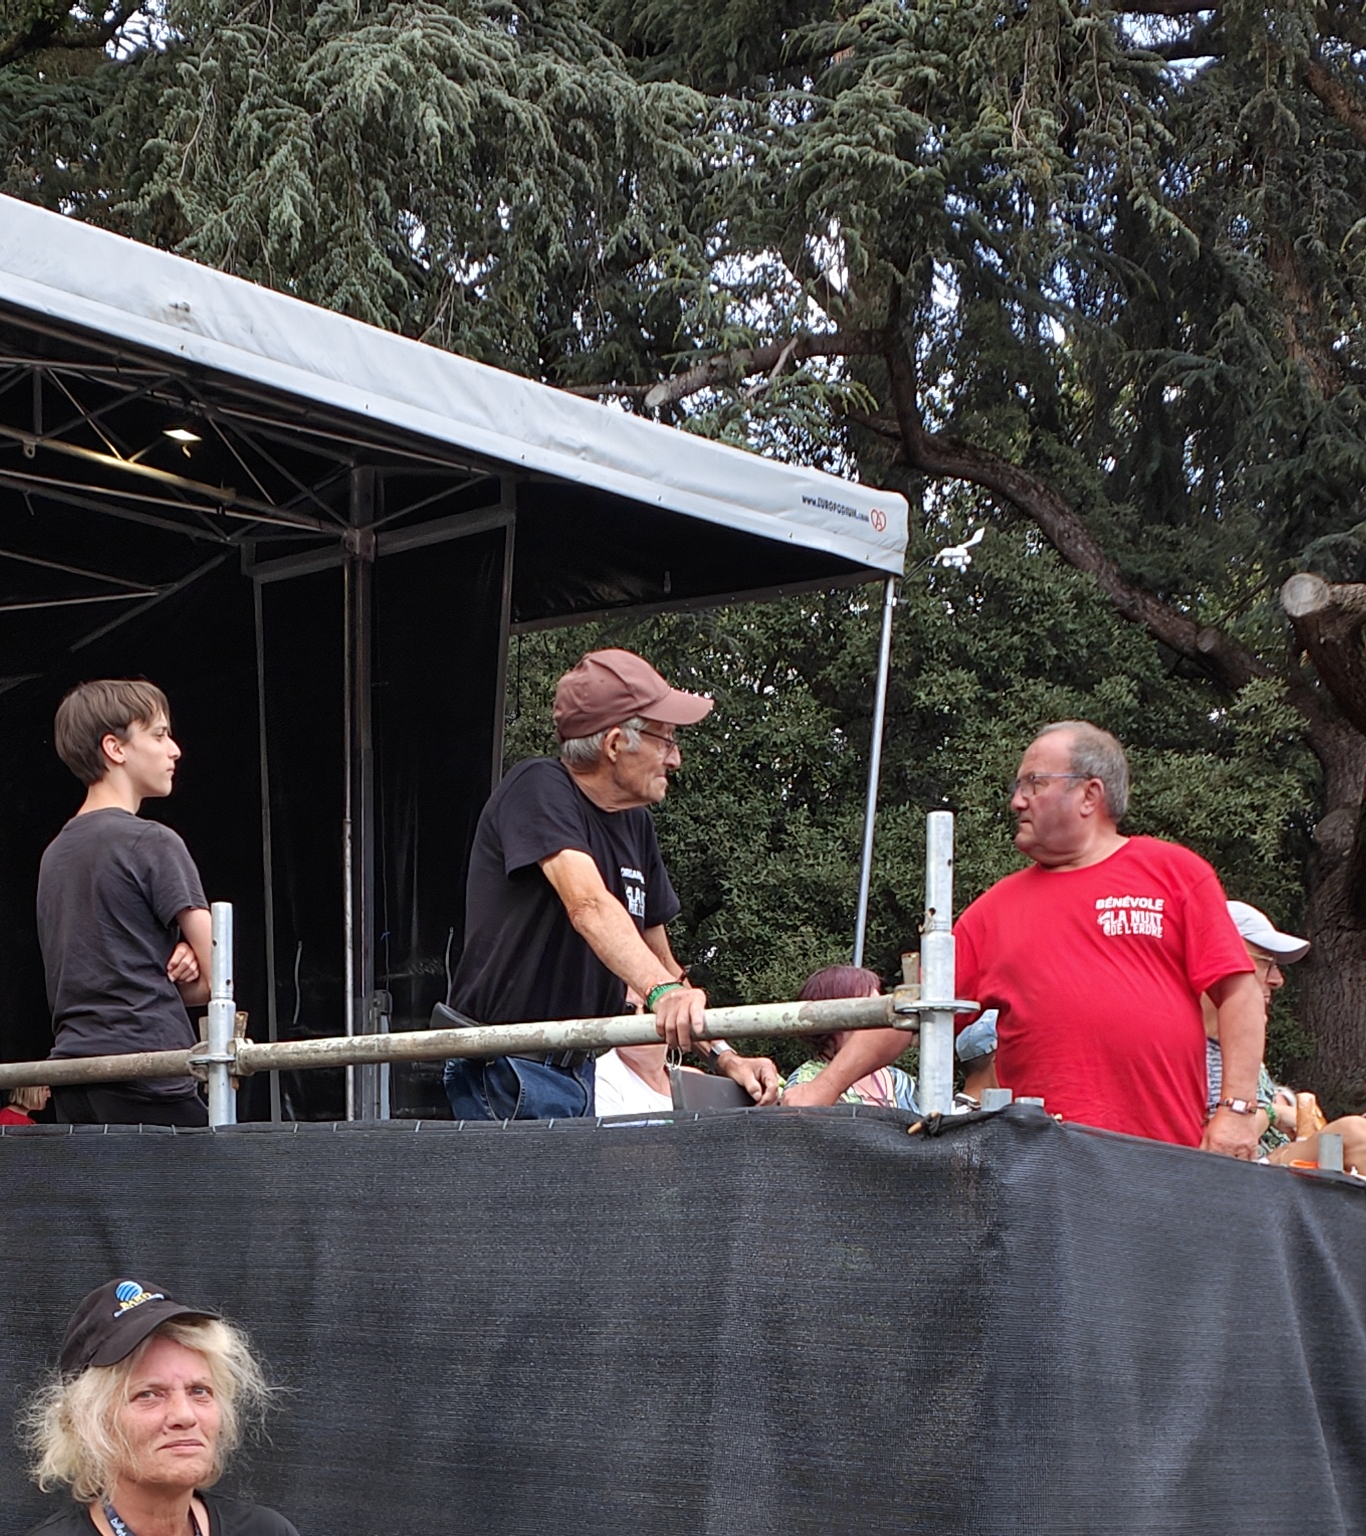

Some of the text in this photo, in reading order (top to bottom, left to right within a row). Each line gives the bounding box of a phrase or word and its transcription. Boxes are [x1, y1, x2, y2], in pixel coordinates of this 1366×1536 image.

[1095, 895, 1165, 911] BÉNÉVOLE
[1110, 910, 1163, 927] LA NUIT
[1111, 922, 1123, 936] DE
